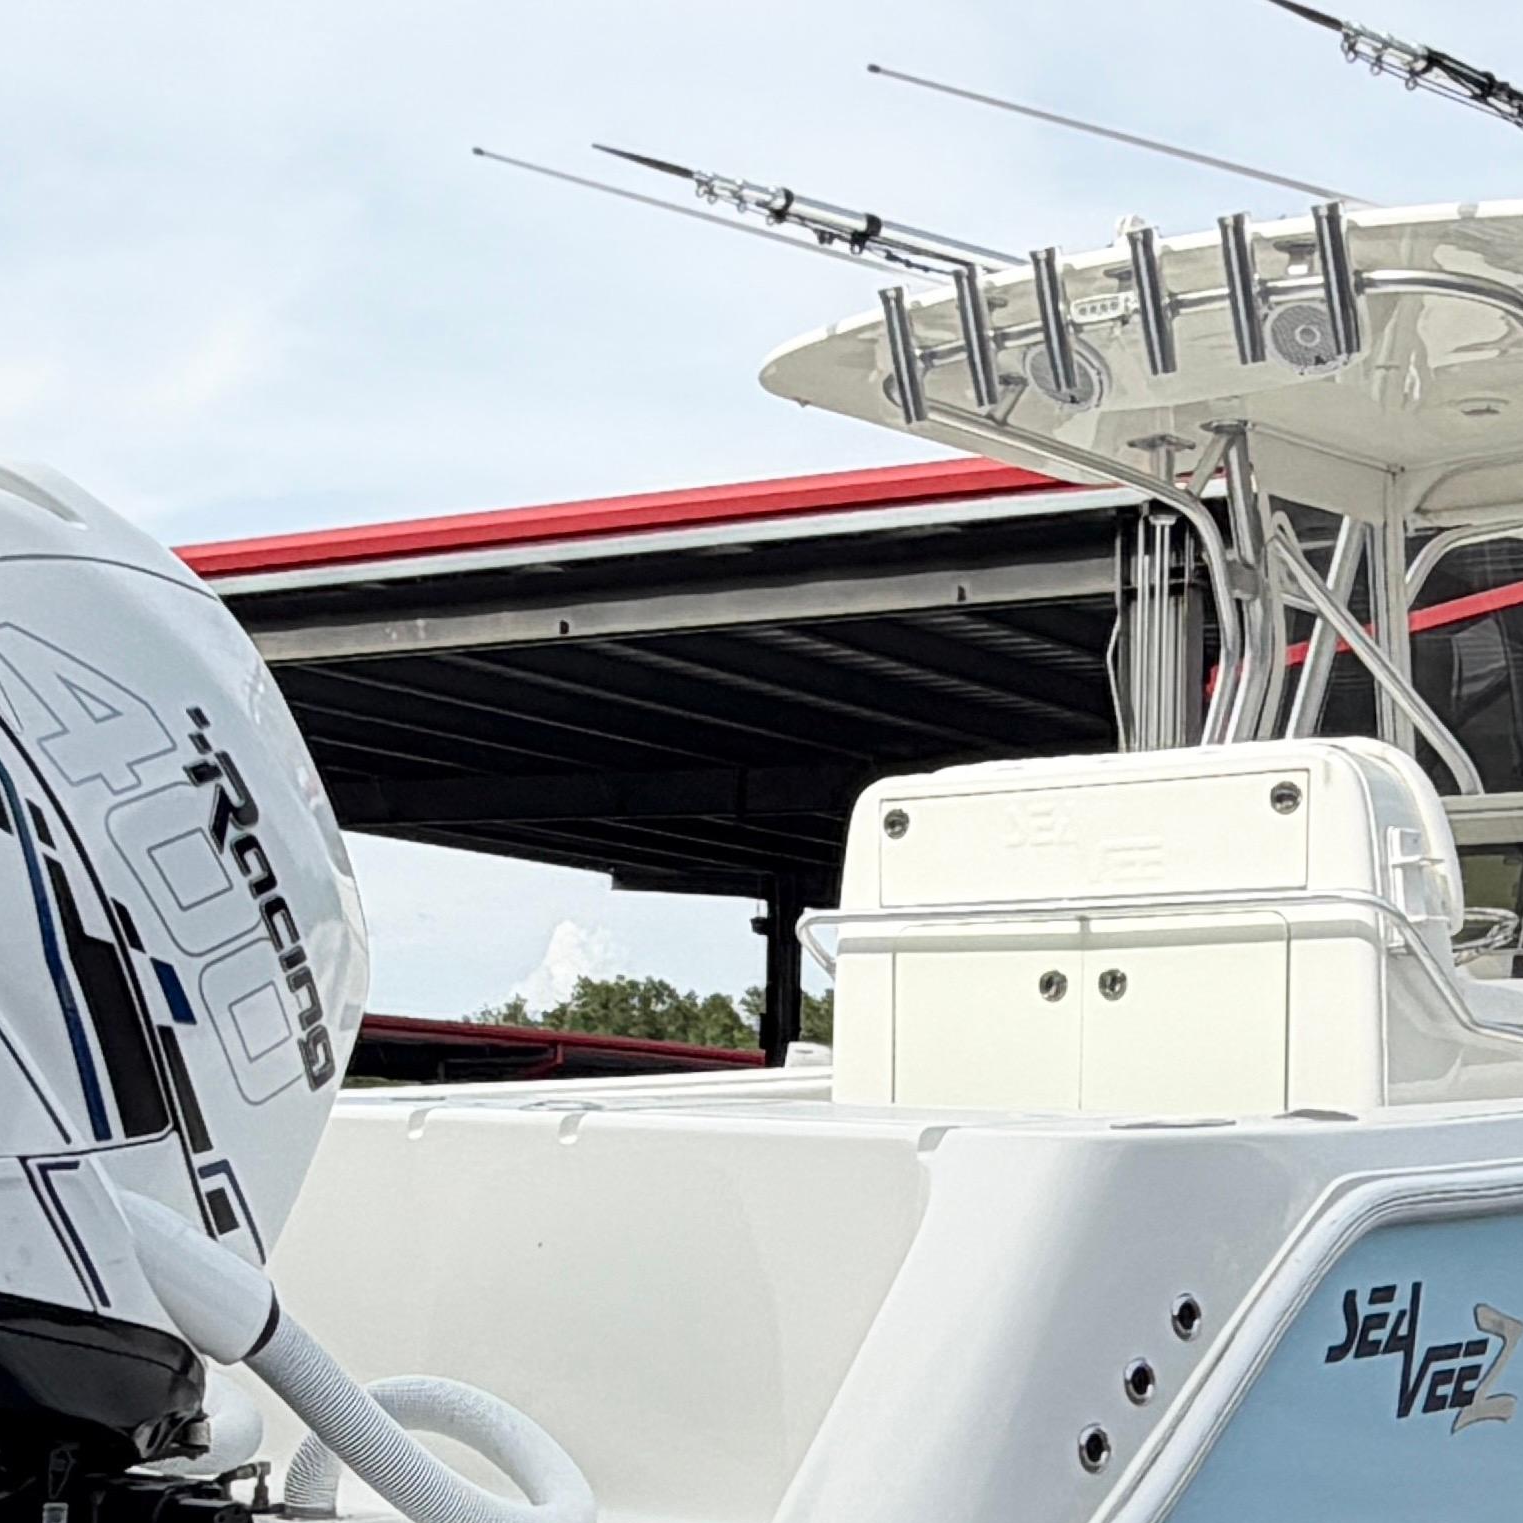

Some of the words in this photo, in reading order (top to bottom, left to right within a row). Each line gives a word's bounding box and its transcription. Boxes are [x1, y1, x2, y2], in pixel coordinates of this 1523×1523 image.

[183, 750, 336, 1092] Racing
[1324, 1281, 1422, 1364] SEA
[1396, 1338, 1490, 1419] VEE
